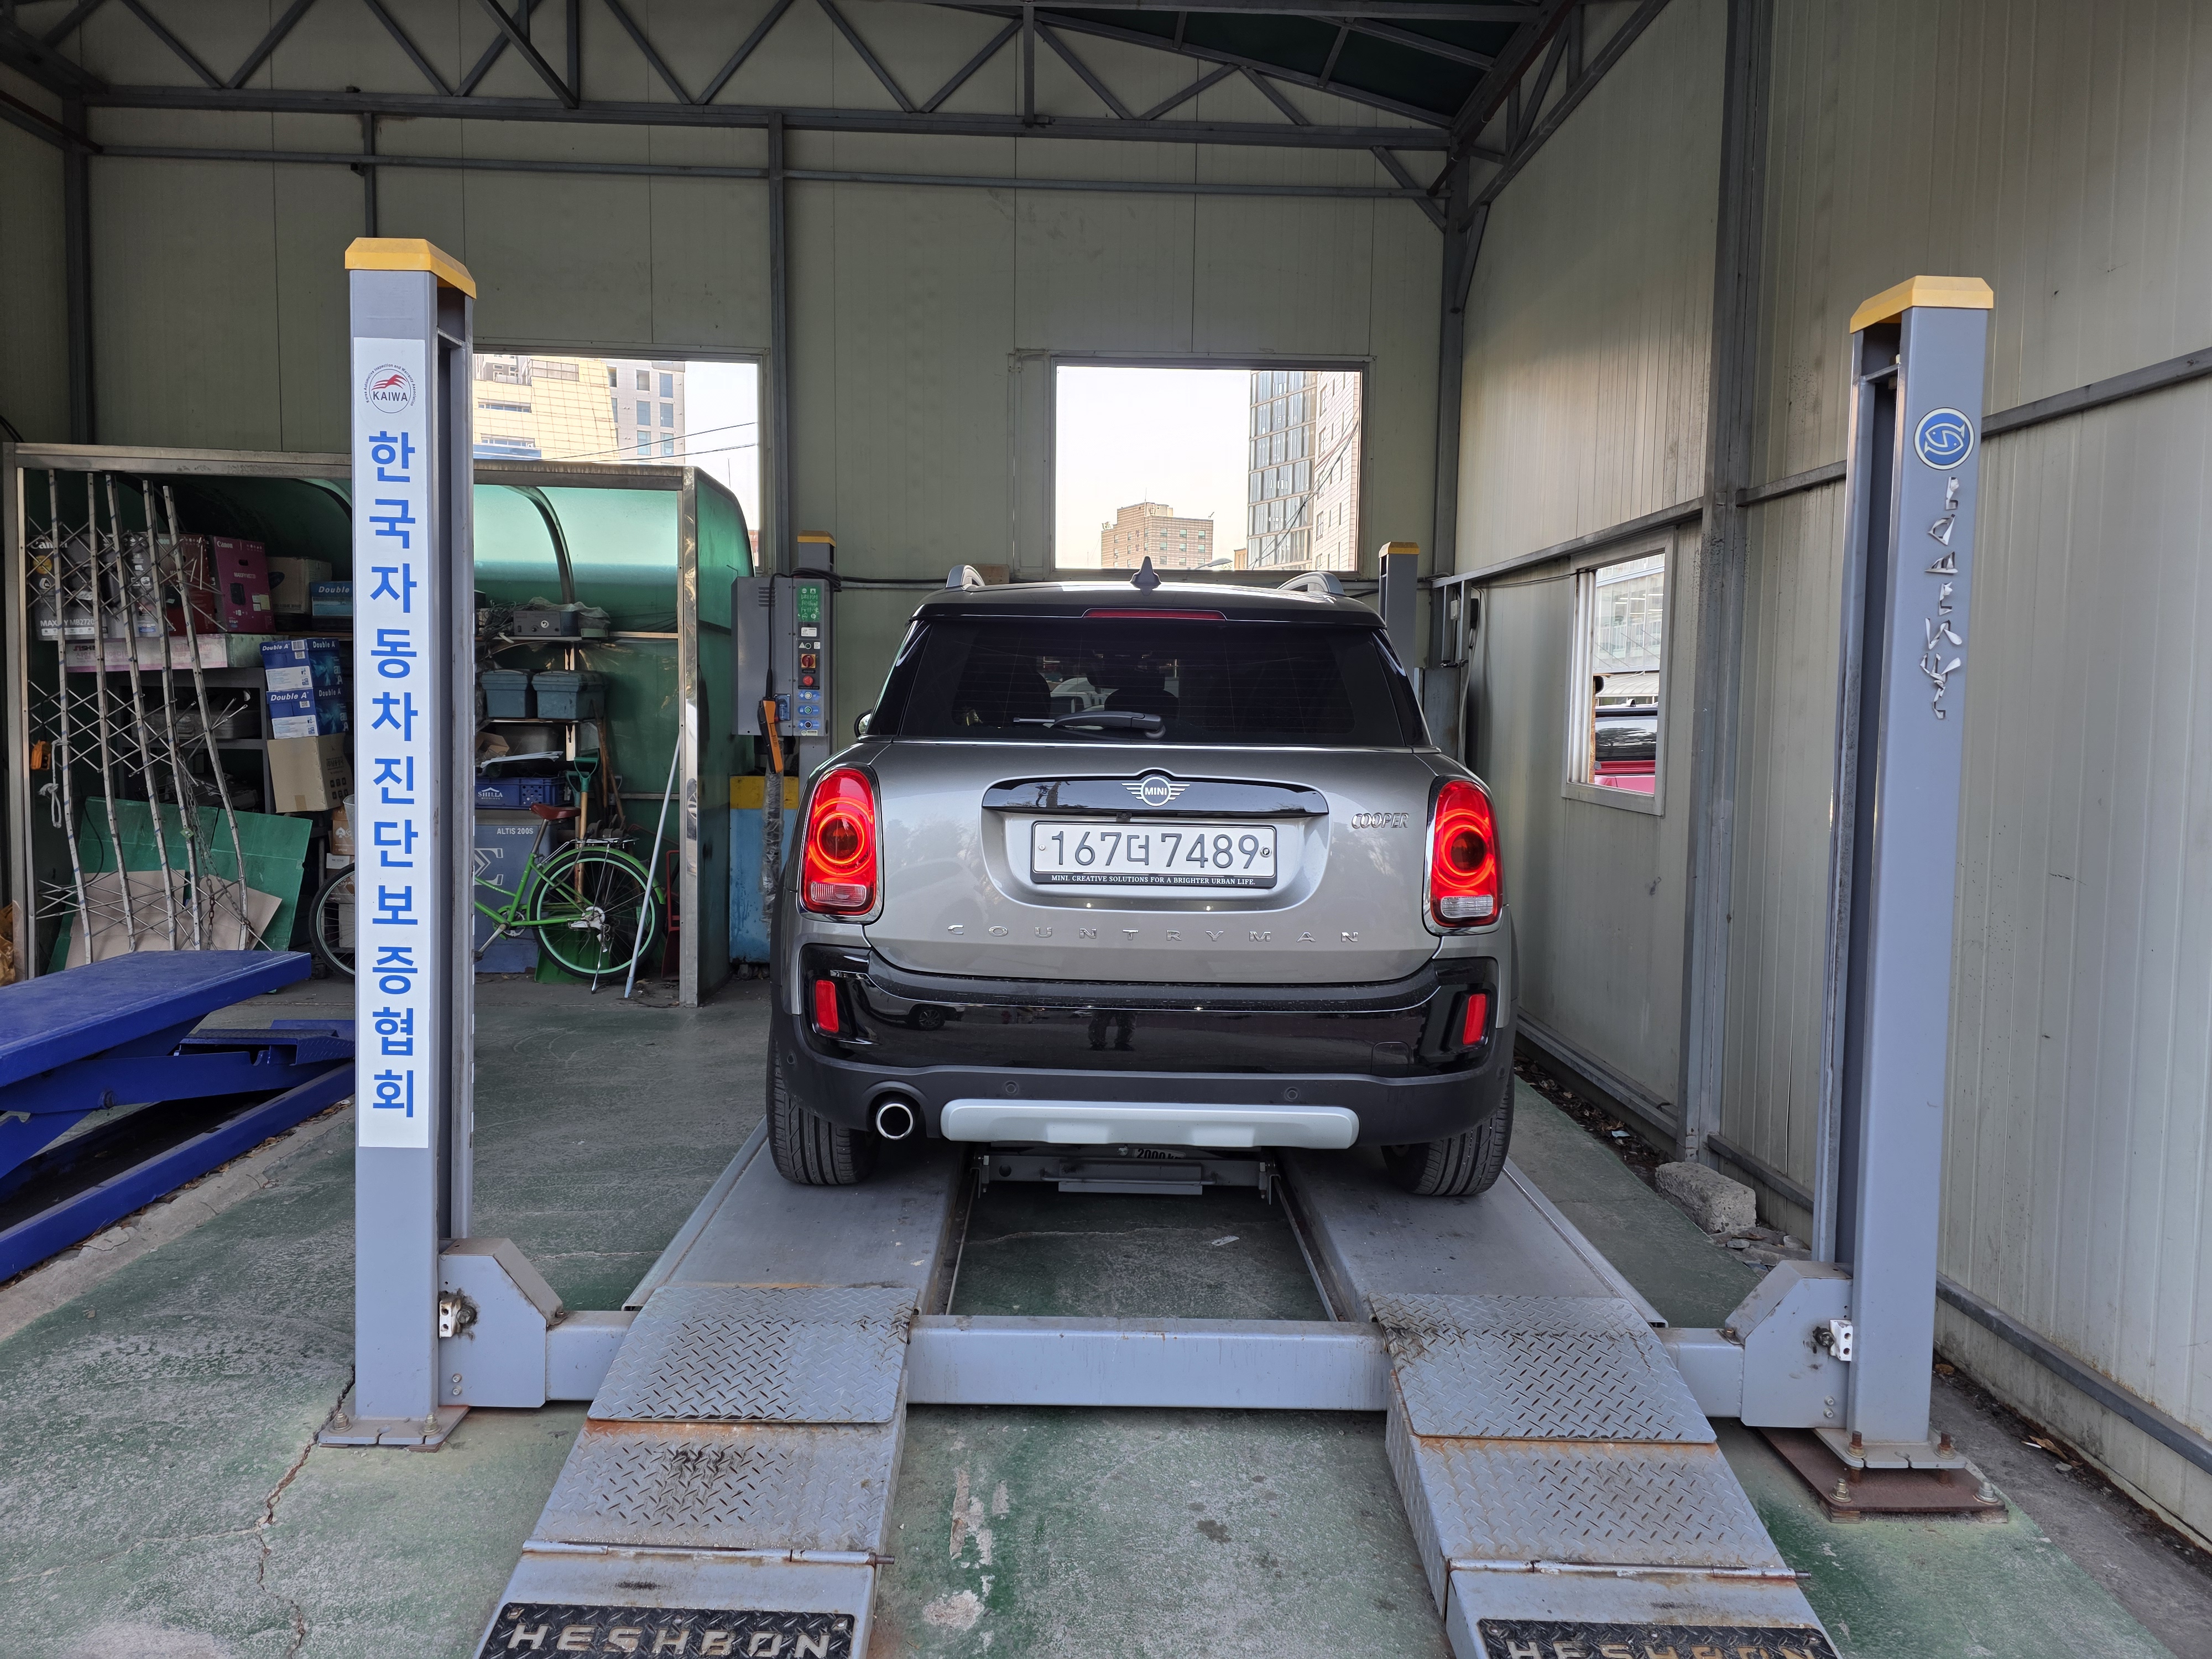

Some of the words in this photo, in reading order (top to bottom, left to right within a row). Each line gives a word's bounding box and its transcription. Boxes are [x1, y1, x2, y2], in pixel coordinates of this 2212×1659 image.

[364, 370, 375, 390] Automotive
[374, 363, 393, 372] Inspection
[401, 367, 414, 383] Warranty
[373, 391, 408, 401] KAIWA
[30, 539, 68, 549] Cann
[216, 540, 233, 549] Canon
[270, 693, 299, 701] Double
[319, 688, 336, 697] Double
[369, 431, 418, 1117] 한국자동차진단보증협회
[1145, 787, 1167, 795] MINI
[1351, 812, 1410, 830] COOPER
[1051, 831, 1150, 866] 167더
[1161, 833, 1260, 869] 7489
[947, 925, 1359, 943] COUNTRYMAN
[1136, 1148, 1166, 1159] 2000
[507, 1623, 831, 1658] HESHBON
